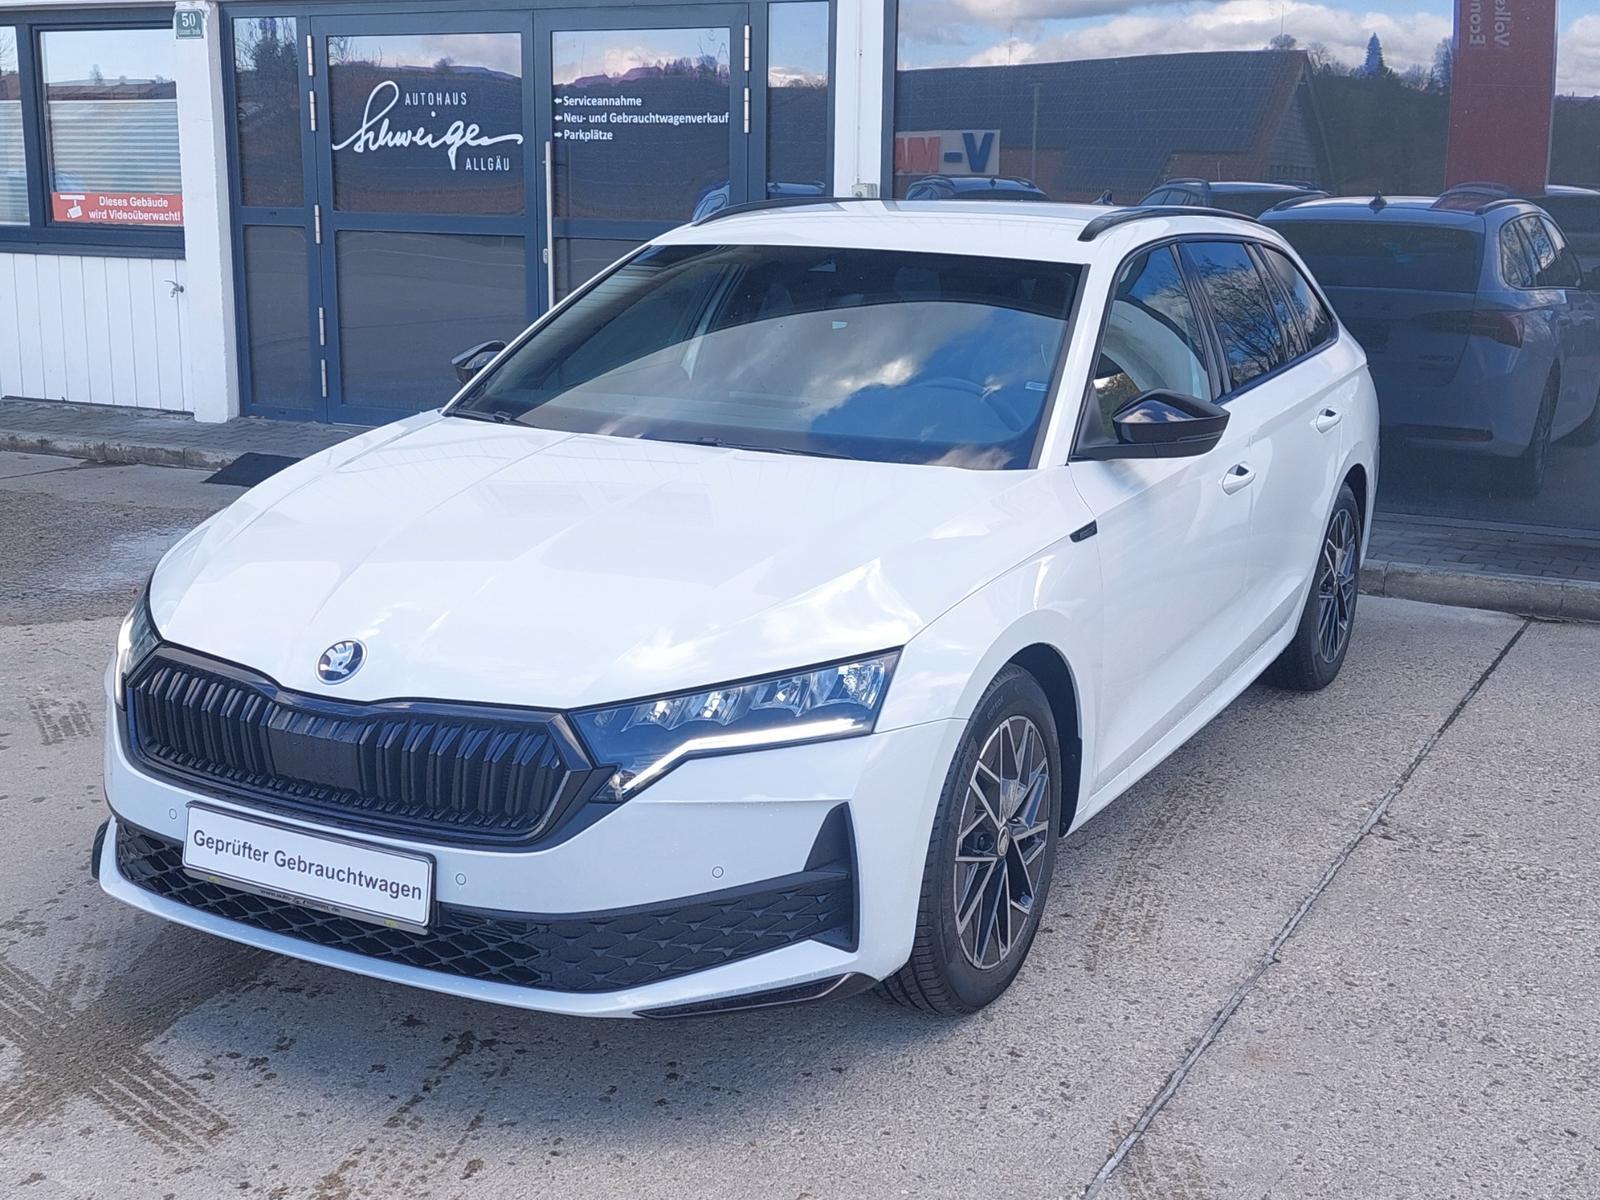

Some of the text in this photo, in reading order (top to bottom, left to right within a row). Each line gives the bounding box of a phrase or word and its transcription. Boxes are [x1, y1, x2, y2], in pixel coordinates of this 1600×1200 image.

[181, 12, 196, 28] 50
[404, 92, 468, 107] AUTOHAUS
[563, 95, 643, 107] Serviceannahme
[563, 112, 730, 126] Neu- und Gebrauchtwagenverkauf
[563, 129, 614, 142] Parkplätze
[465, 155, 511, 172] ALLGÄU
[99, 196, 169, 209] Dieses Gebäude
[88, 208, 181, 222] wird Videoüberwacht!
[193, 829, 269, 864] Geprüfter
[274, 849, 422, 901] Gebrauchtwagen
